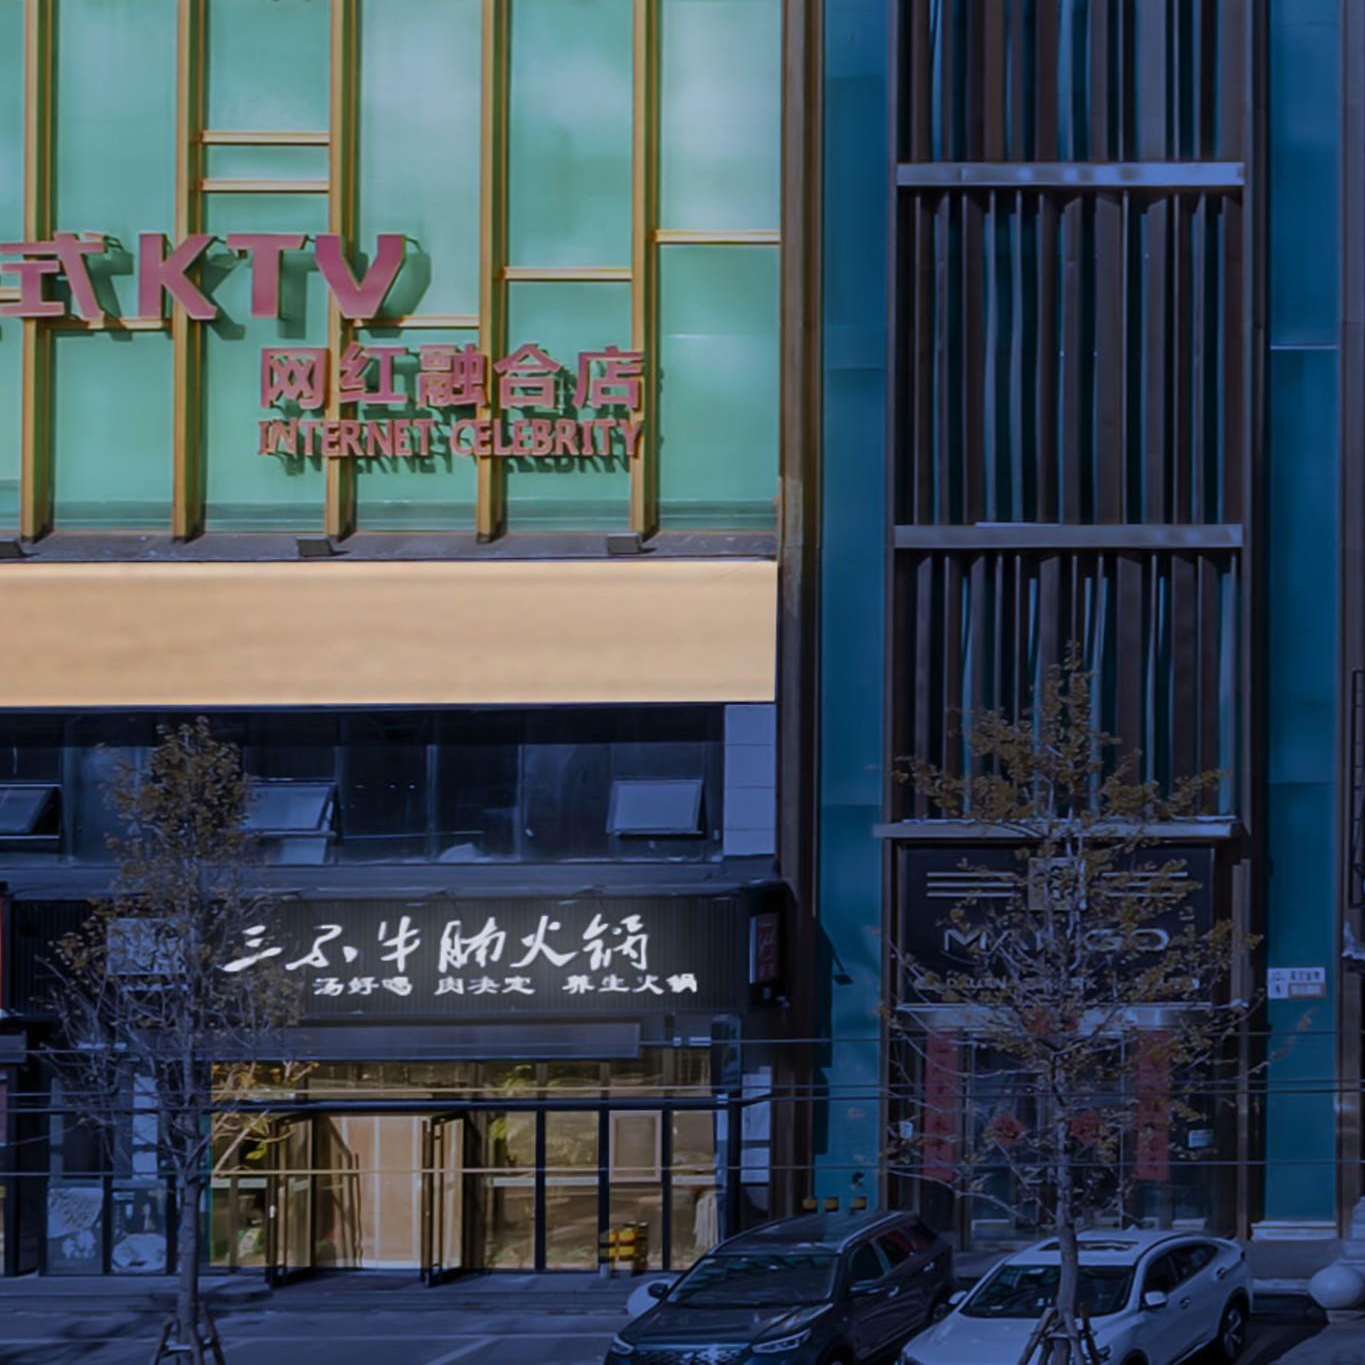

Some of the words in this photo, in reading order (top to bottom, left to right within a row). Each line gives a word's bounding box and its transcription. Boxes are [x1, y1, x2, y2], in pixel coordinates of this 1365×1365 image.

[259, 341, 645, 411] 网红融合店
[258, 418, 436, 458] INTERNET
[449, 418, 645, 458] CELEBRITY
